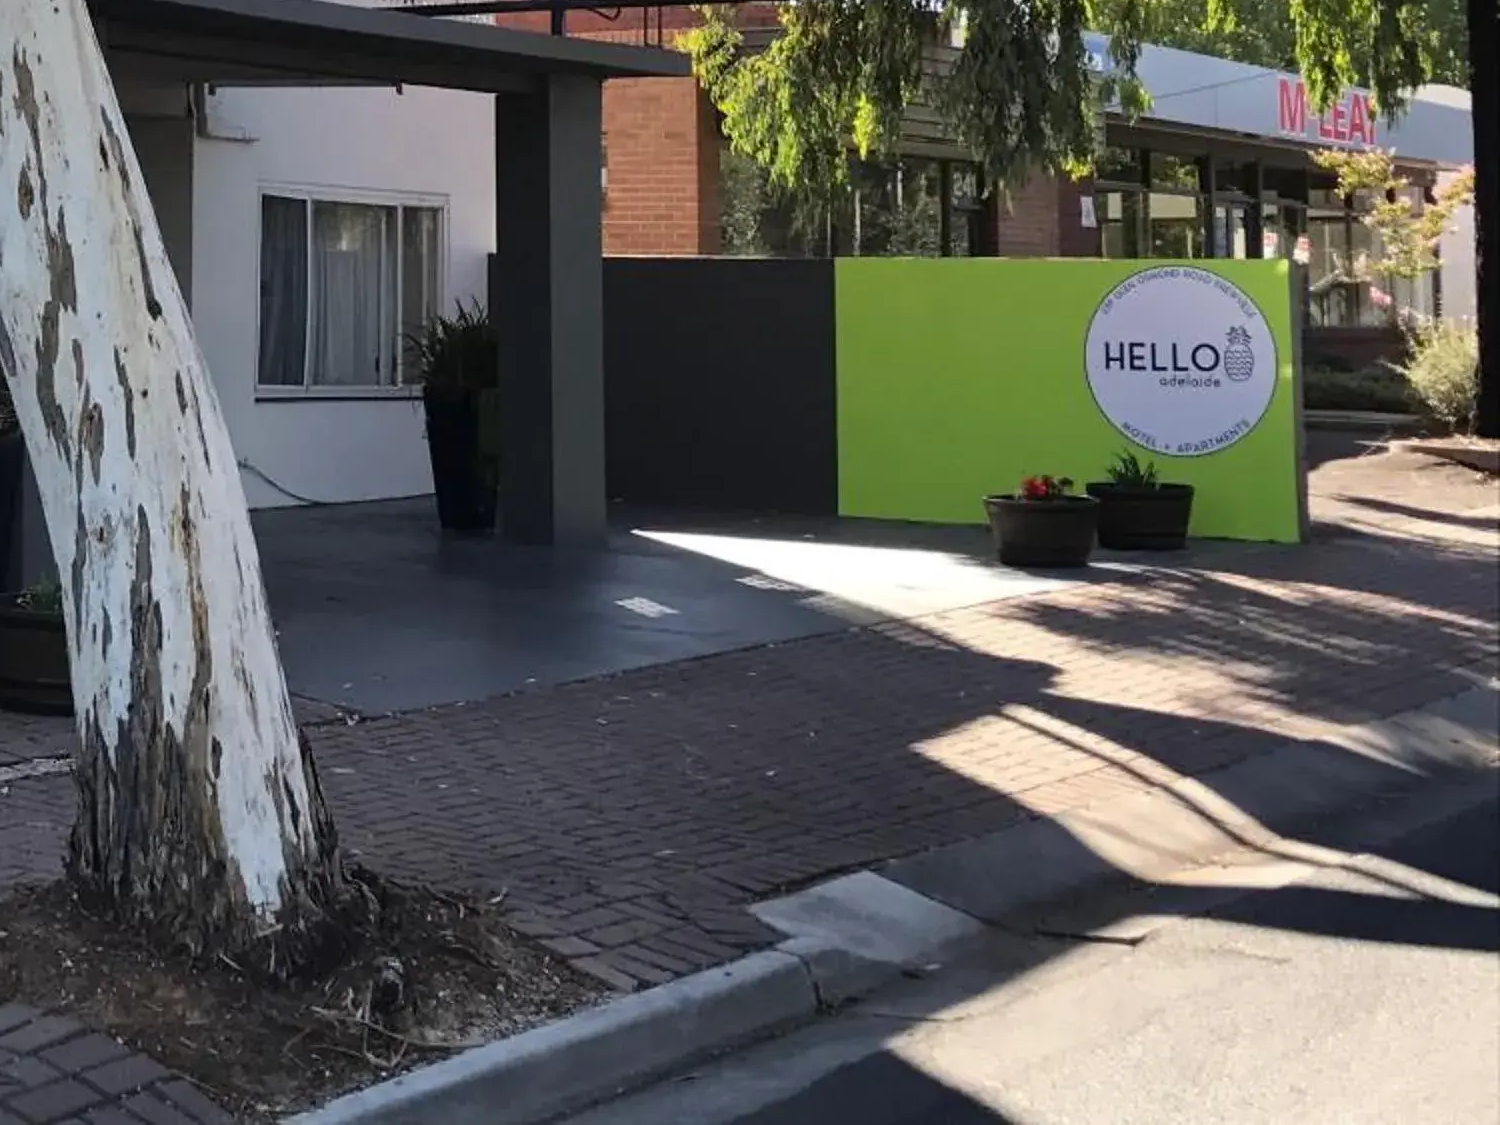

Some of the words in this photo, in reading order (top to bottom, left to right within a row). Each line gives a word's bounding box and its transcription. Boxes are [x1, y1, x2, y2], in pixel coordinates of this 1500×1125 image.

[1104, 341, 1220, 372] HELLO
[1159, 373, 1221, 388] adelaide
[1122, 421, 1157, 448] MOTEL
[1176, 418, 1250, 453] APARTMENTS
